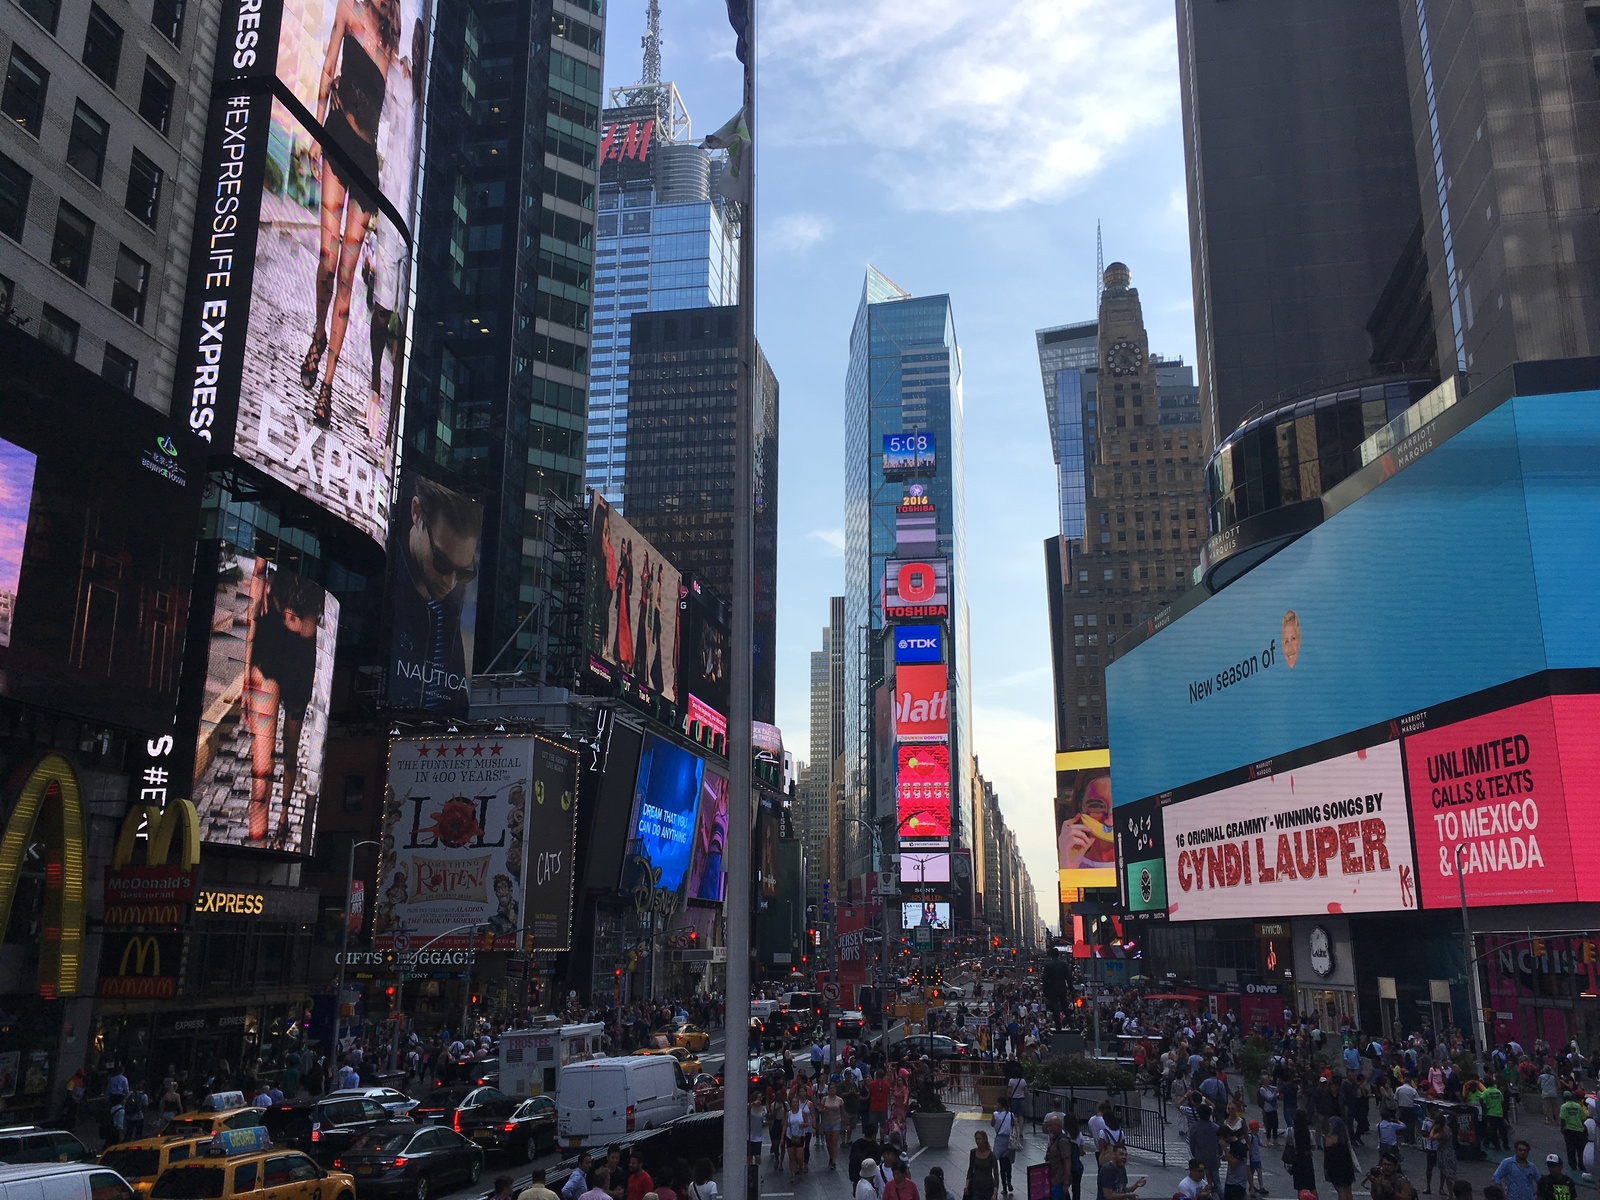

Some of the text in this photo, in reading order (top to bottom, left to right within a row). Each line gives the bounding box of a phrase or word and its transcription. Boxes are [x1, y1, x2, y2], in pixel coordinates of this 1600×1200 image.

[205, 96, 250, 289] #EXPRESSLIFE
[890, 436, 928, 451] 5:08
[1396, 422, 1437, 454] MARRIOTT
[1398, 438, 1434, 468] MARQUIS
[896, 505, 934, 513] TOSHIBA
[903, 496, 928, 505] 2016
[1208, 526, 1241, 550] MARRIOTT
[1209, 539, 1237, 560] MARQUIS
[887, 605, 947, 617] TOSHIBA
[907, 639, 937, 648] TDK
[397, 660, 469, 692] NAUTICA
[1189, 639, 1276, 704] New season of
[1401, 711, 1428, 724] MARRIOTT
[1401, 721, 1426, 734] MARQUIS
[398, 757, 521, 770] THE FUNNIEST MUSICAL
[1256, 760, 1273, 770] MARRIOTT
[1427, 734, 1530, 784] UNLIMITED
[415, 771, 429, 783] IN
[433, 771, 456, 783] 400
[1256, 767, 1272, 777] MARQUIS
[1432, 769, 1534, 809] CALLS & TEXTS
[643, 803, 689, 828] DREAM THAT YOU
[1176, 834, 1185, 848] 16
[1187, 825, 1225, 846] ORIGINAL
[1323, 797, 1363, 821] SONGS
[1365, 792, 1383, 813] BY
[1434, 798, 1538, 842] TO MEXICO
[639, 820, 687, 843] CAN DO ANYTHING
[1177, 818, 1391, 892] CYNDI LAUPER
[1439, 834, 1544, 876] & CANADA
[422, 861, 480, 869] SOMETHING
[537, 851, 562, 886] CATS
[108, 876, 191, 891] McDonald's
[413, 861, 488, 898] ROTTEN!
[120, 890, 175, 899] Restaurant
[195, 892, 263, 914] EXPRESS
[838, 931, 863, 948] JERSEY
[842, 946, 860, 961] BOYS
[1256, 984, 1278, 993] NYC
[175, 1019, 205, 1031] EXPRESS
[510, 1037, 550, 1049] FROSTEE
